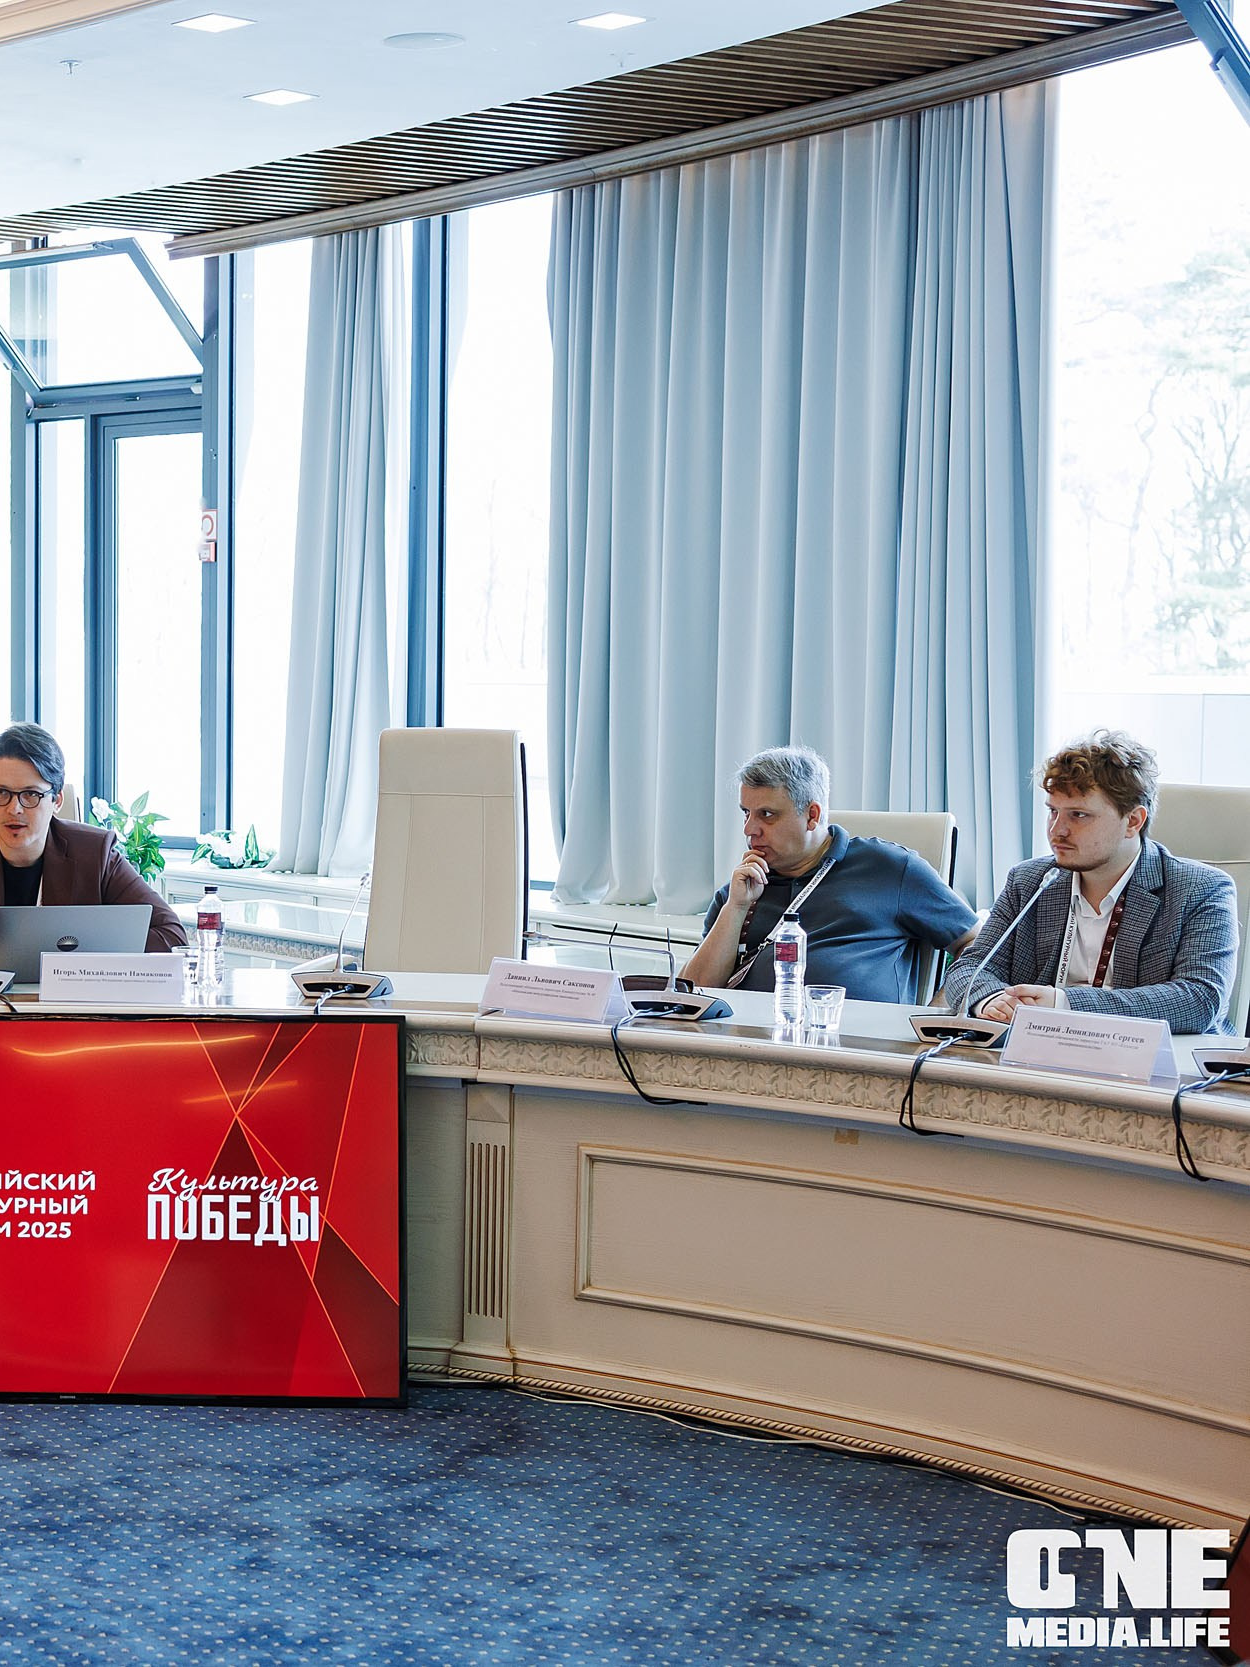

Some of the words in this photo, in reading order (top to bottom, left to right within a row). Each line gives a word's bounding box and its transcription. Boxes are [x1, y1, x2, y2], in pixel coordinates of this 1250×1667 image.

[1063, 924, 1075, 962] КУЛЬТУРНЫЙ
[53, 968, 77, 978] Игорь
[78, 968, 128, 977] Михайлович
[504, 972, 531, 982] Даниил
[531, 975, 562, 985] Львович
[562, 979, 596, 989] Саксонов
[1058, 962, 1067, 983] ФОРУМ
[1025, 1021, 1061, 1034] Дмитрий
[1062, 1026, 1112, 1039] Леонидович
[1112, 1031, 1145, 1044] Сергеев
[147, 1167, 320, 1203] Культура
[16, 1221, 72, 1239] 2025
[147, 1194, 320, 1247] ПОБЕДЫ
